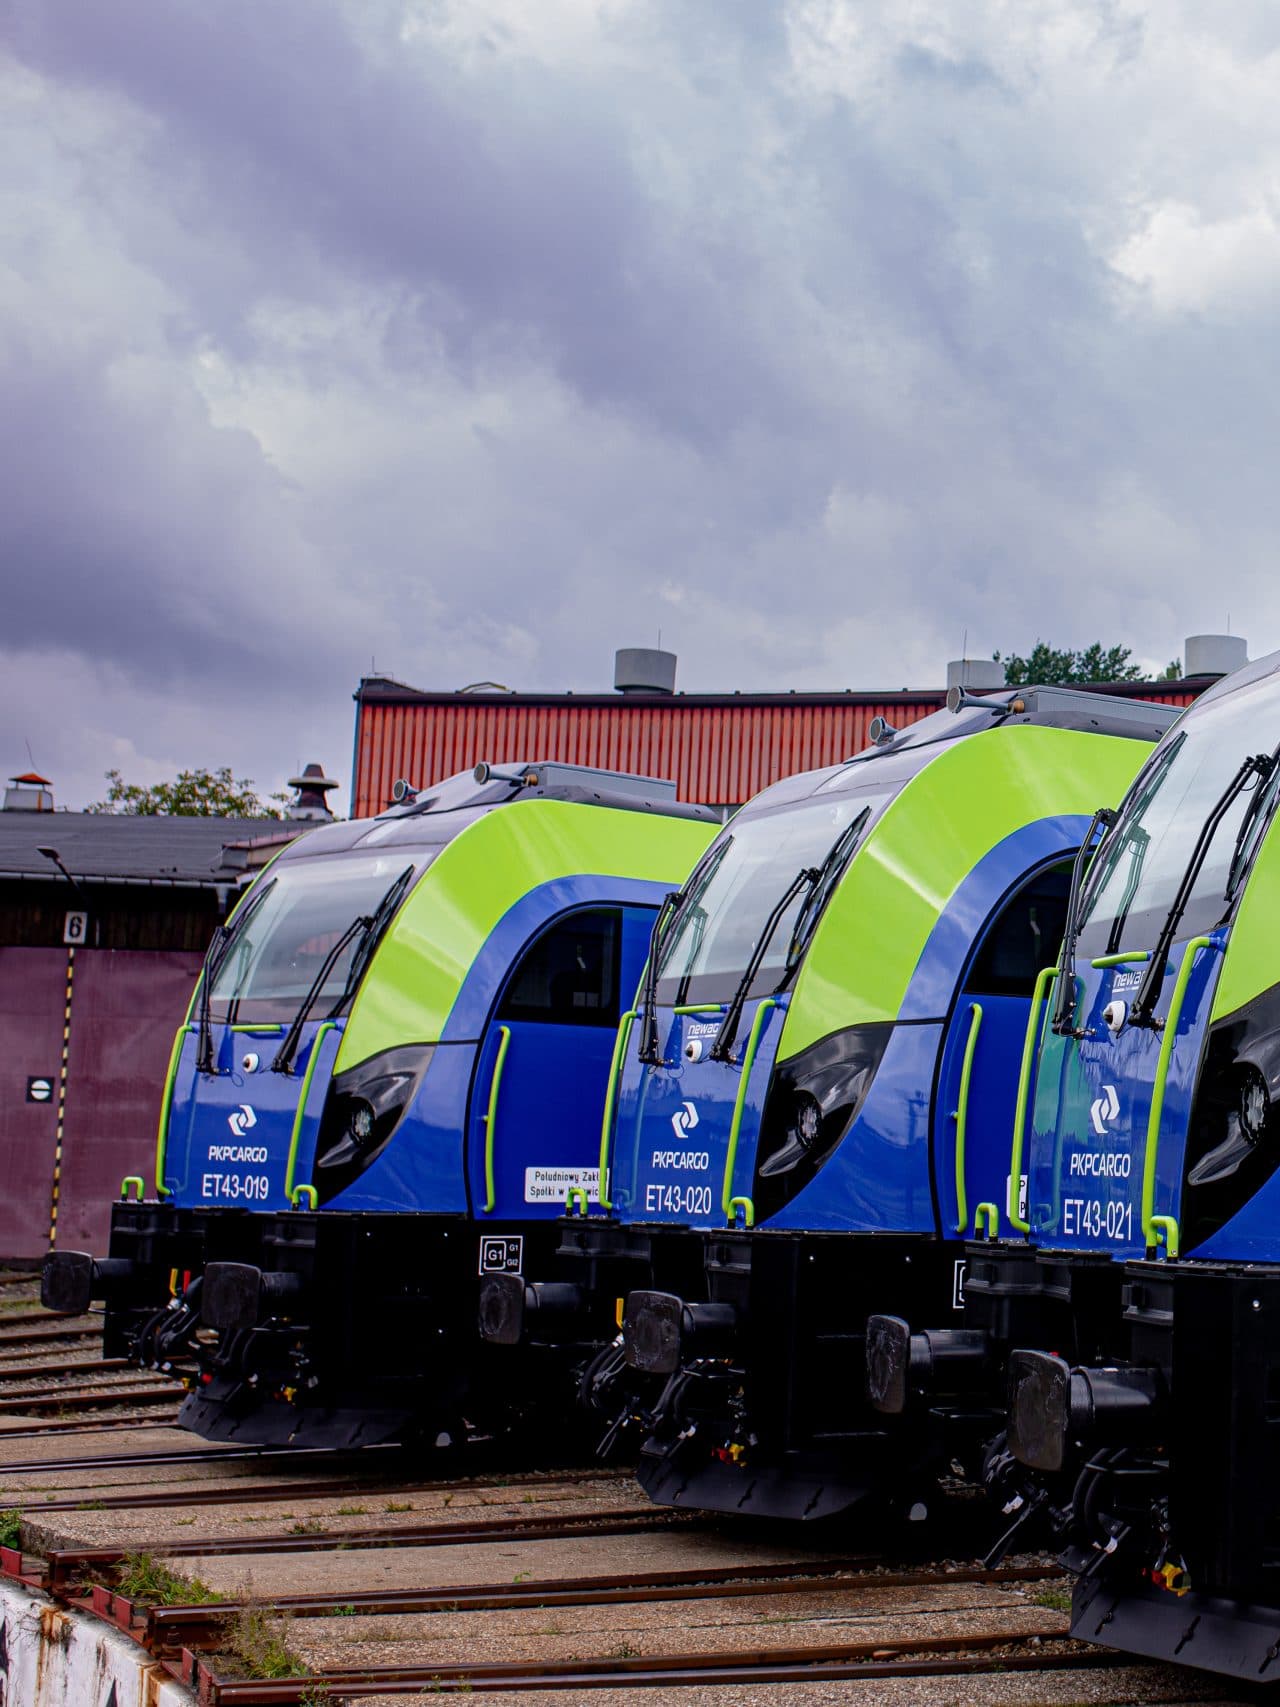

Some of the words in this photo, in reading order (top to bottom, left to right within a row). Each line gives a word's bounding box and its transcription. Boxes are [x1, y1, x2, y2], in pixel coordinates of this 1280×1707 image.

[69, 916, 82, 937] 6
[202, 1174, 269, 1200] ET43-019
[646, 1184, 712, 1215] ET43-020
[1064, 1199, 1132, 1241] ET43-021
[488, 1249, 503, 1261] G1
